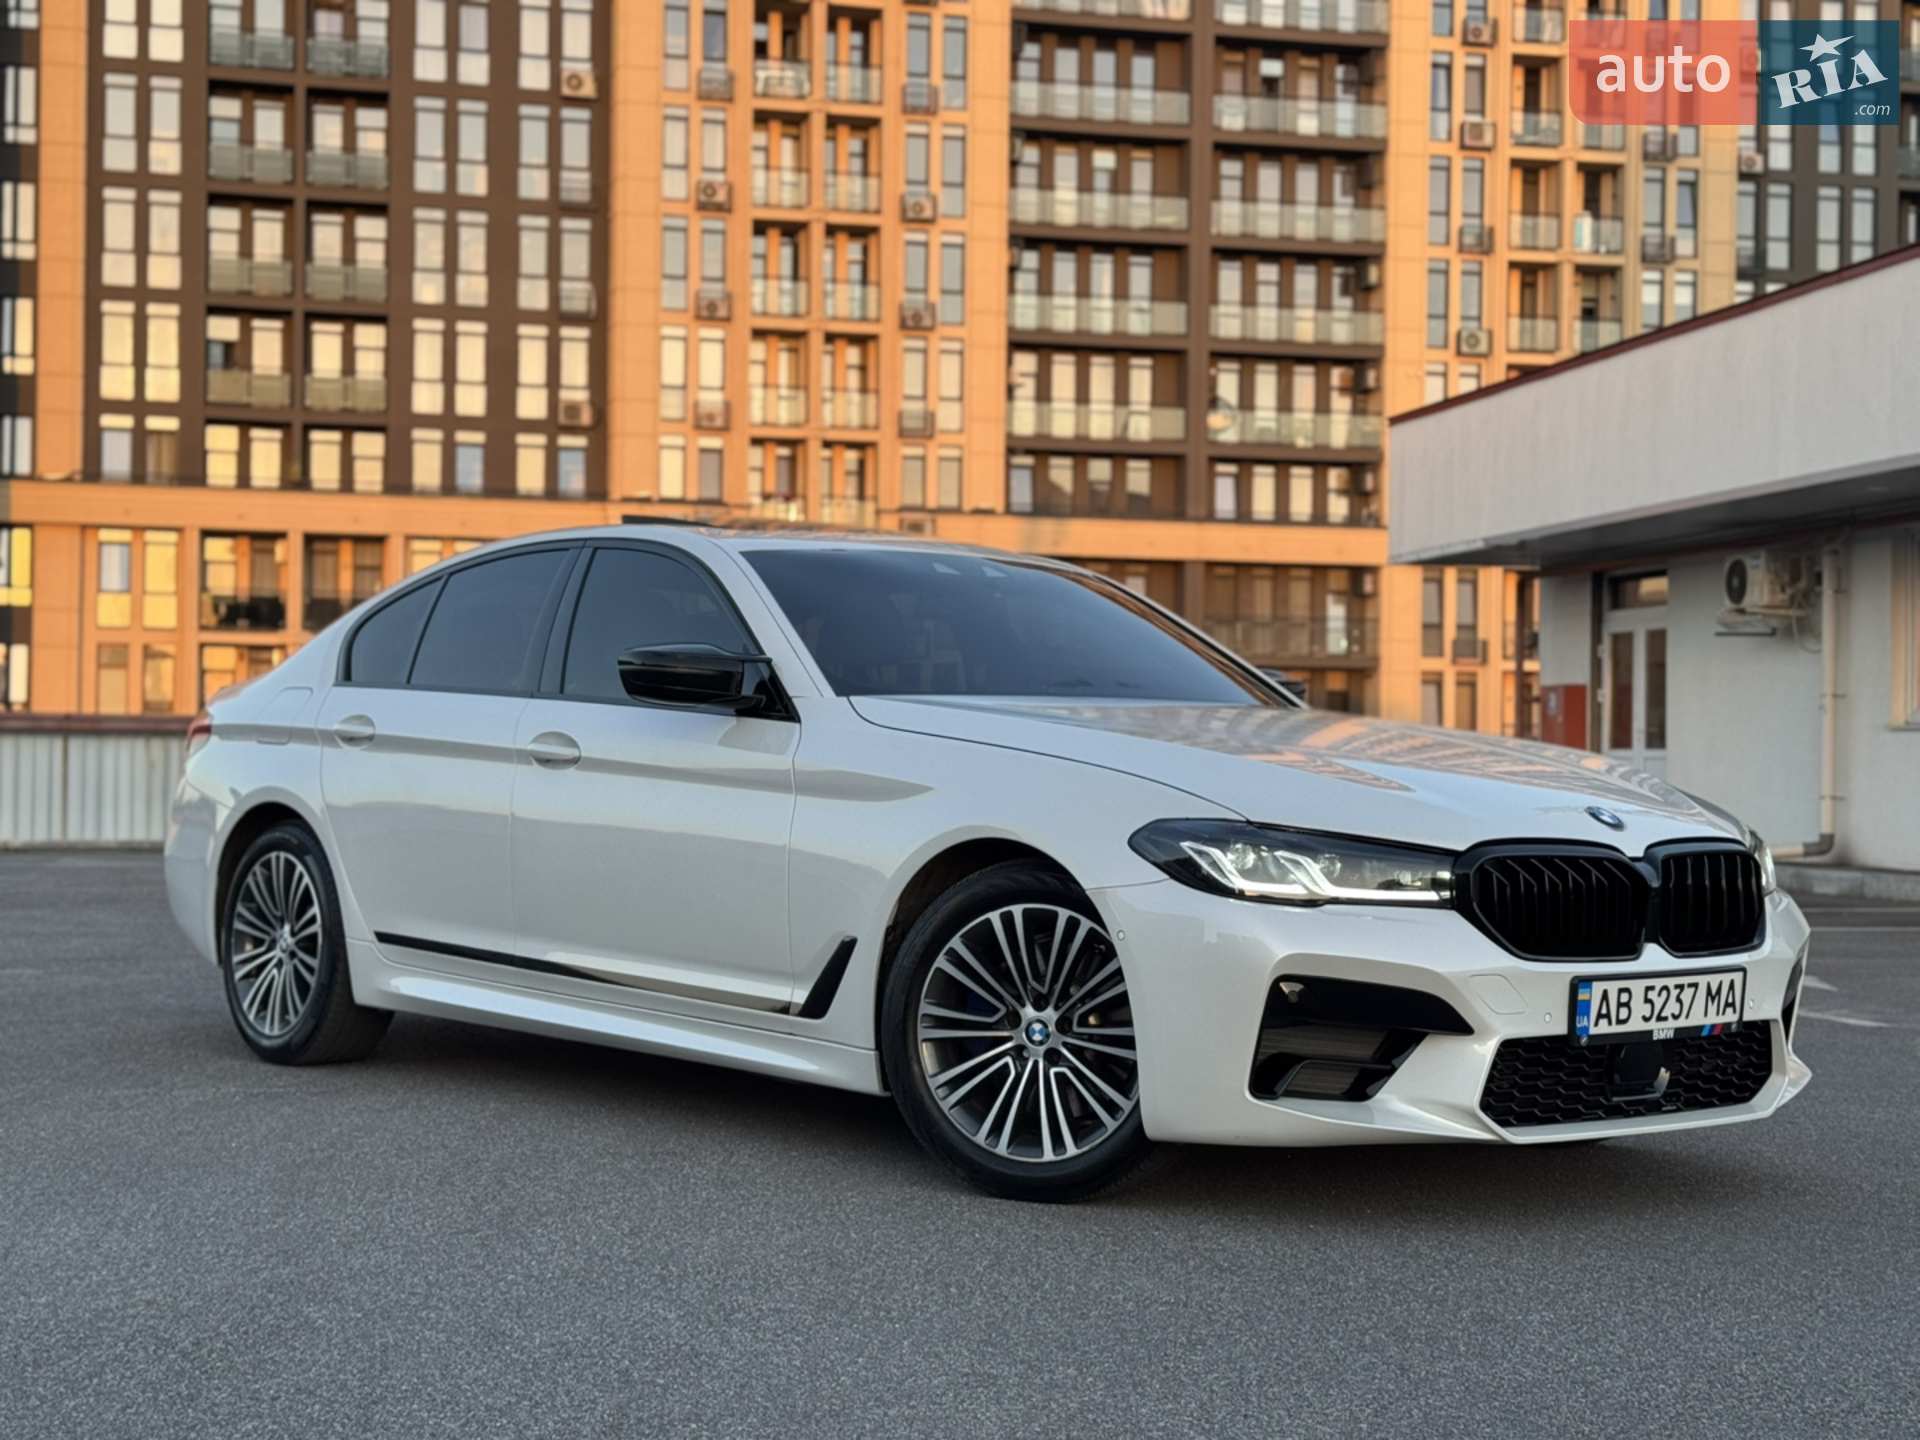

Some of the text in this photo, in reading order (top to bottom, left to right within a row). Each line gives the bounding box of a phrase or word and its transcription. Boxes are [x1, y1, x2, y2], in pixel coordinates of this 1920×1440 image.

[1594, 978, 1737, 1027] AB 5237 MA
[1576, 1016, 1588, 1027] UA
[1652, 1028, 1674, 1040] BMW
